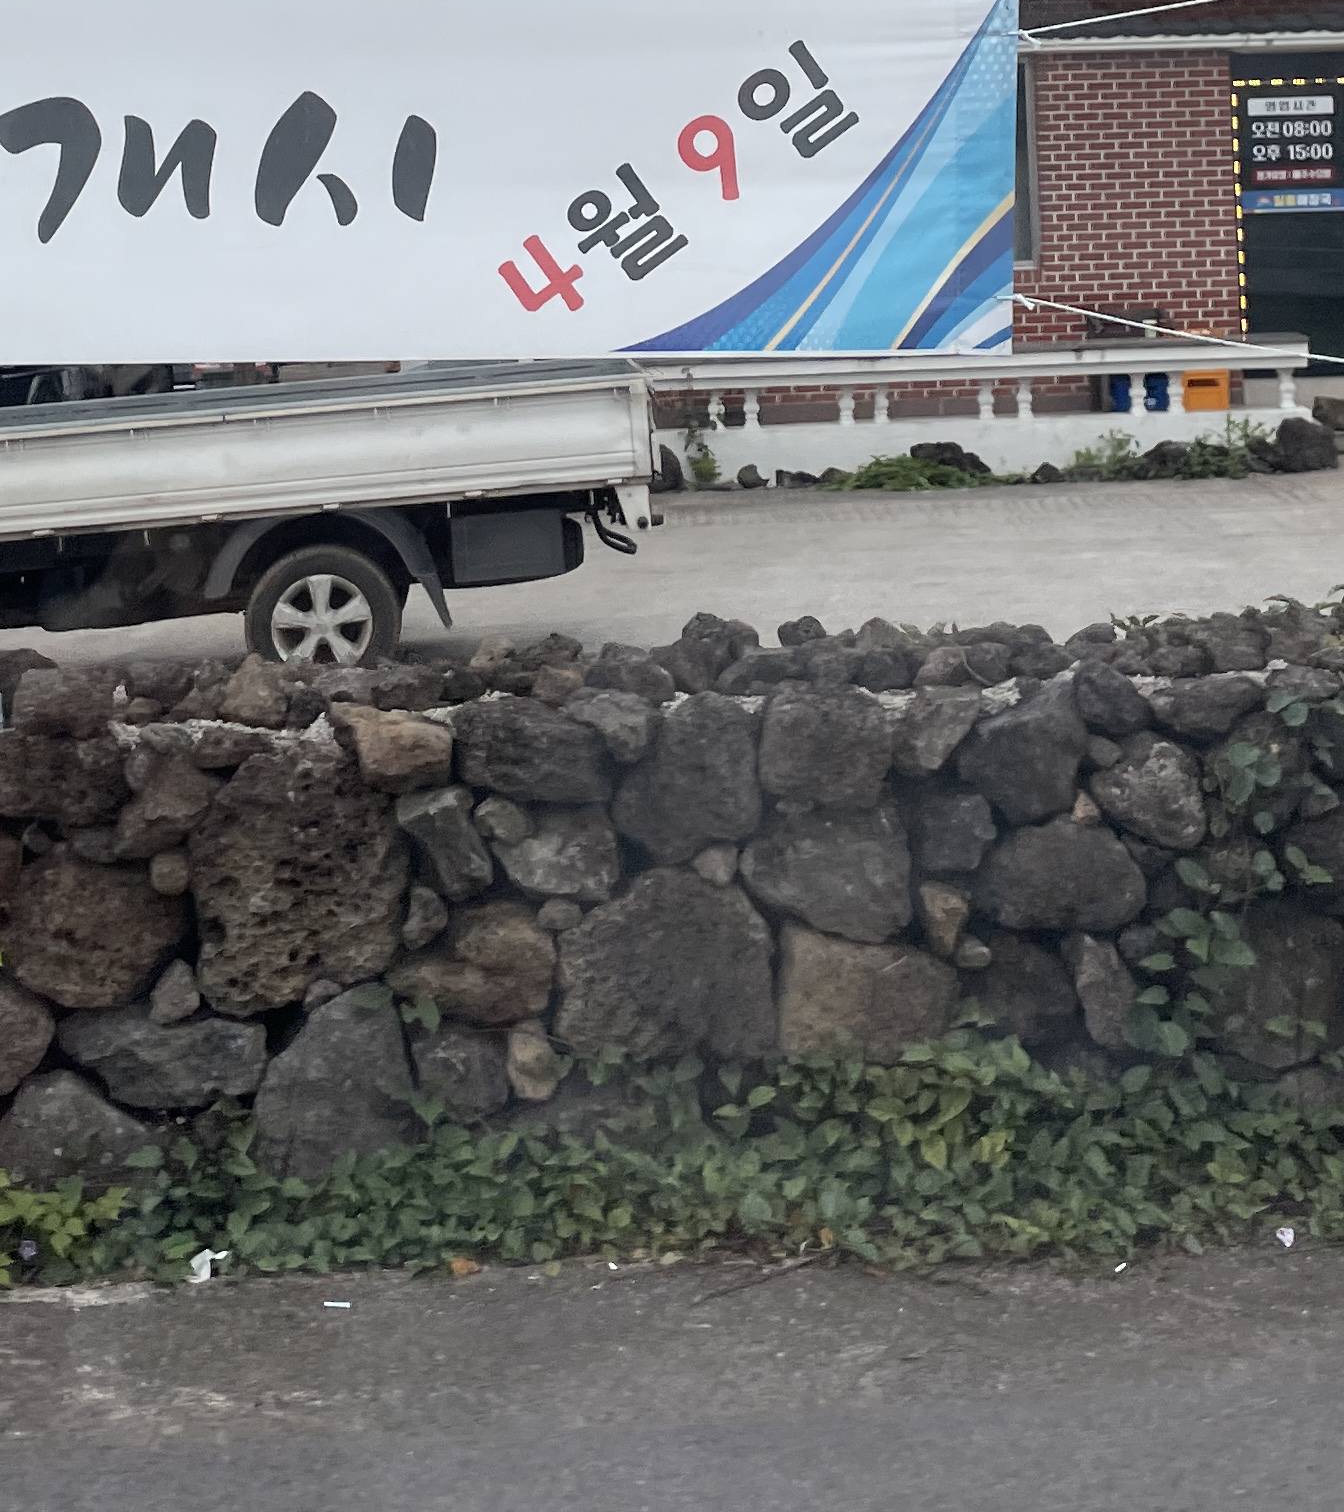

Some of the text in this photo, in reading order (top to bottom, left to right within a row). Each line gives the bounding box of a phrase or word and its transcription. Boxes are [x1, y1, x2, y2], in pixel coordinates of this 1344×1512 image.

[1251, 119, 1333, 139] 오전 08:00
[1252, 143, 1334, 162] 오후 15:00
[499, 41, 860, 312] 4월 9일
